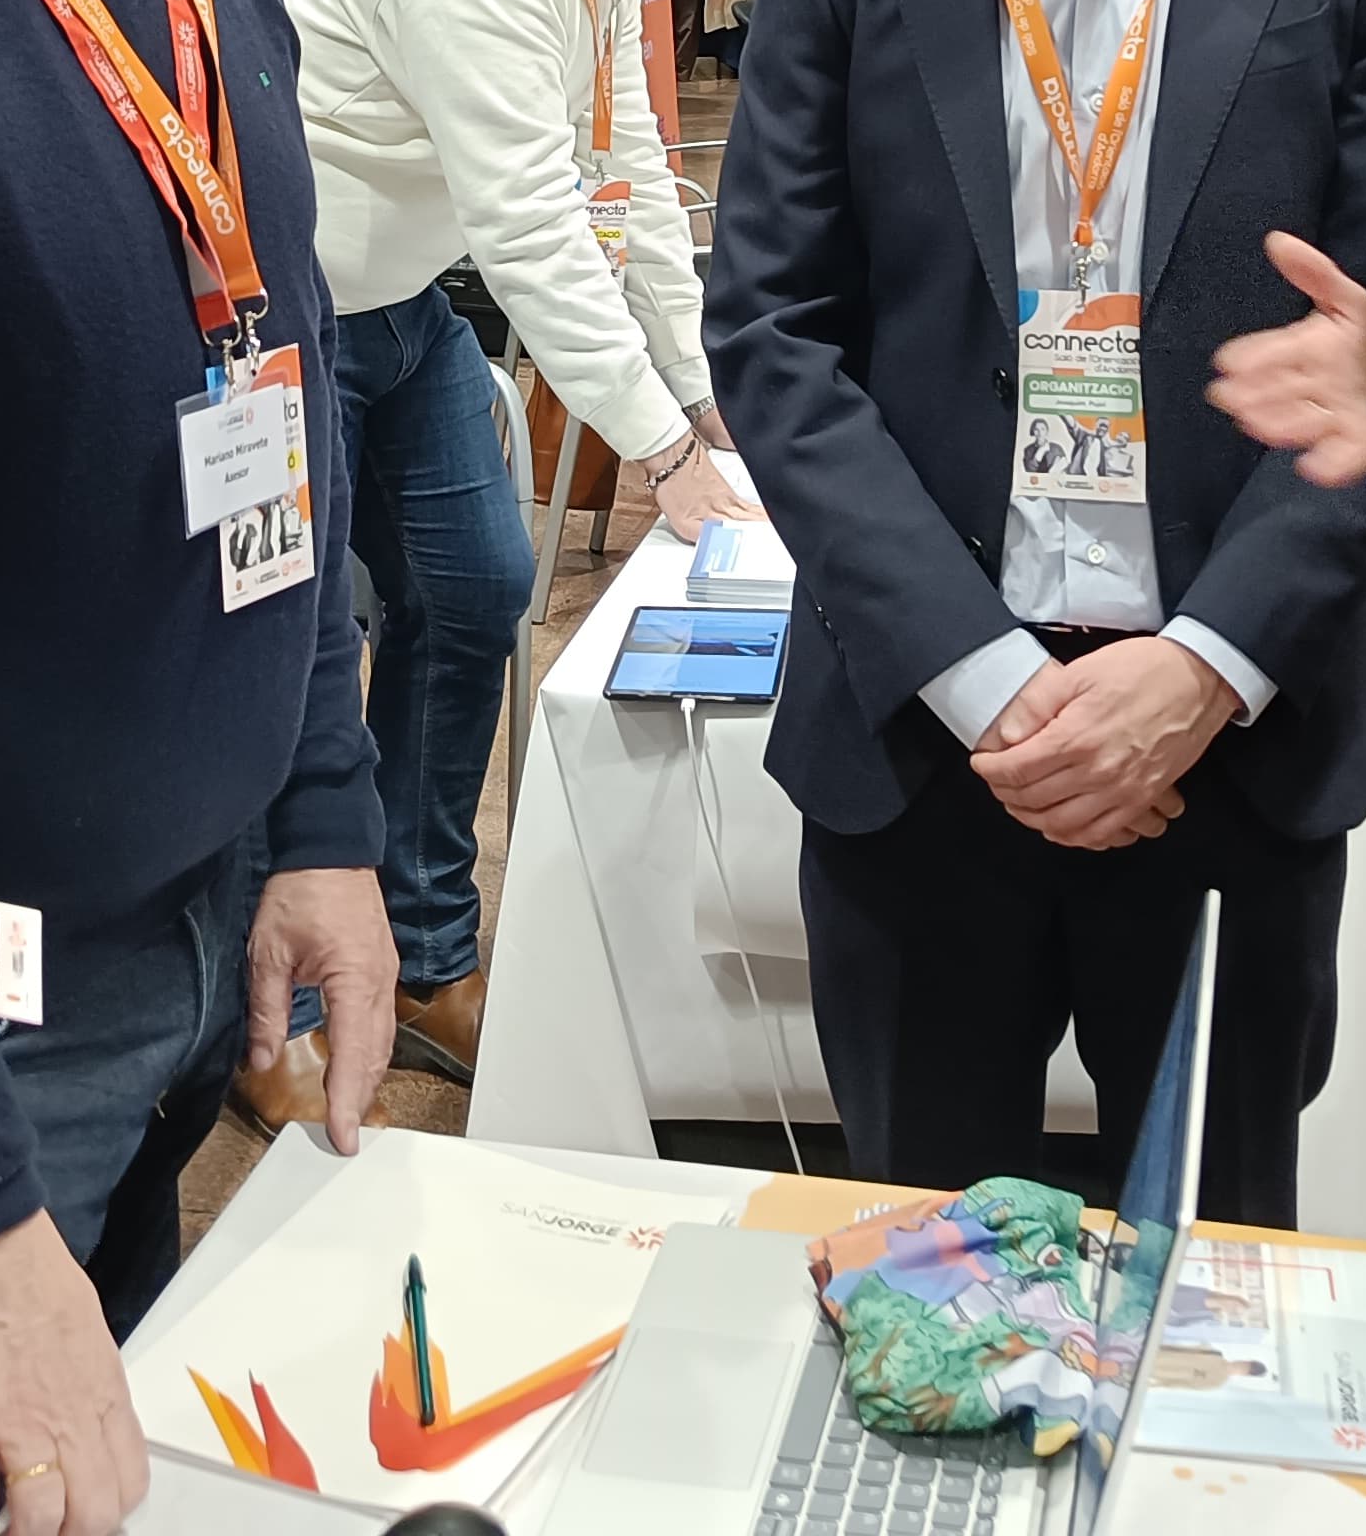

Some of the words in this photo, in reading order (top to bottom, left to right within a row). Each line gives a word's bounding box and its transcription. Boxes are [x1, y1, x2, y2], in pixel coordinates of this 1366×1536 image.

[160, 111, 235, 235] connecta
[1024, 330, 1140, 353] connecta
[1029, 380, 1133, 396] ORGANITZACIÓ
[204, 449, 234, 467] Mariano
